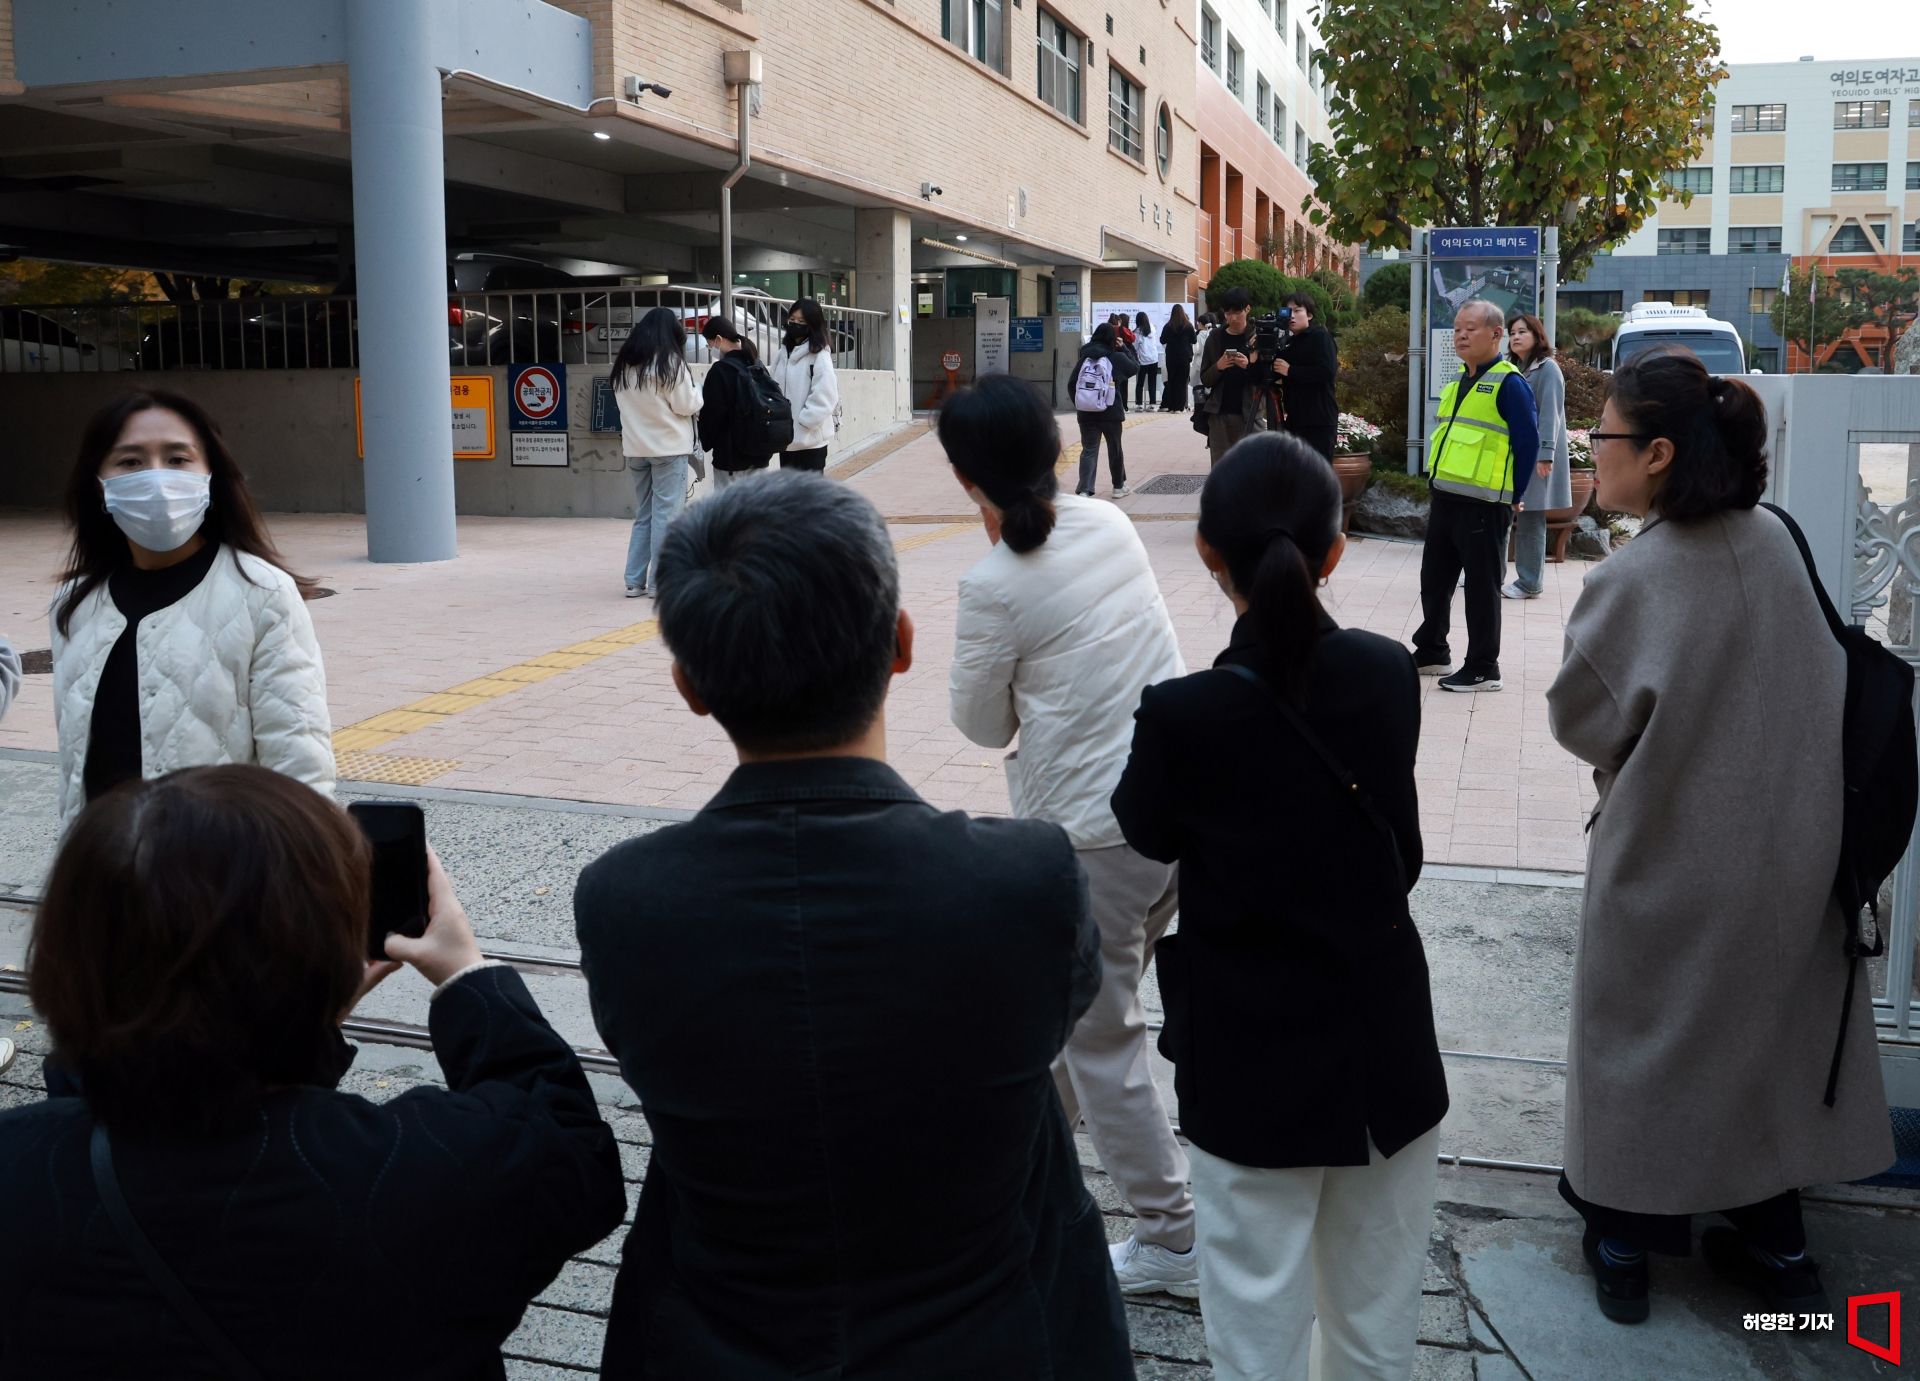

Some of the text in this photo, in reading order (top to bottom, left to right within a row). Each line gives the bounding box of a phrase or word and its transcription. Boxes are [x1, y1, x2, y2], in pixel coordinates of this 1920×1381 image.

[1830, 68, 1920, 86] 여의도여자고
[1831, 88, 1870, 97] YEOUIDO
[1441, 237, 1527, 248] 여의도여고 배치도
[1016, 327, 1025, 340] P
[522, 387, 552, 397] 공회전금지
